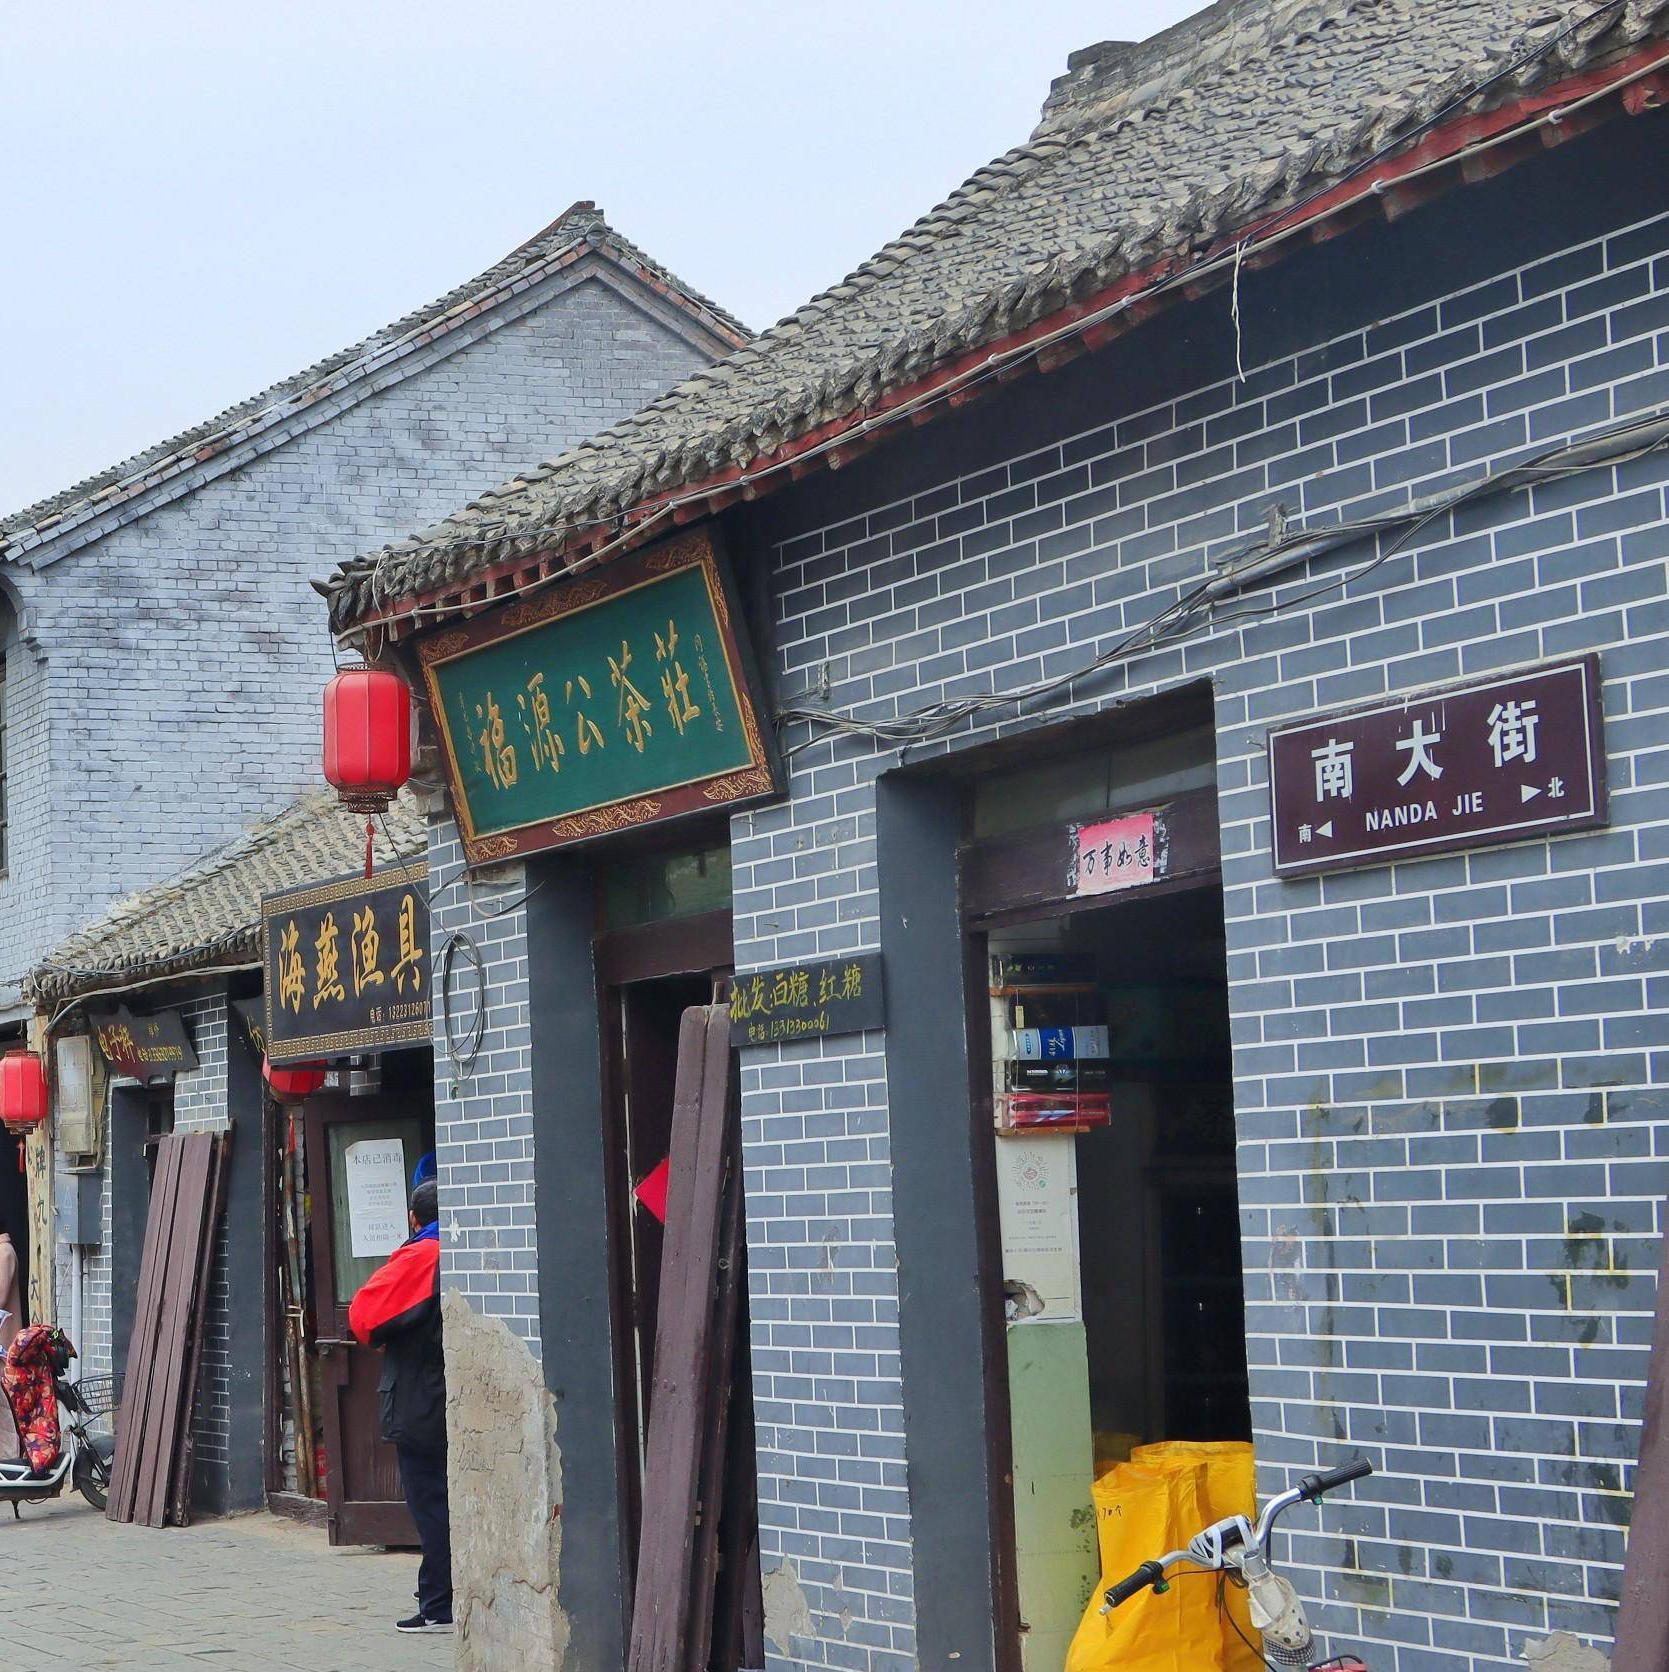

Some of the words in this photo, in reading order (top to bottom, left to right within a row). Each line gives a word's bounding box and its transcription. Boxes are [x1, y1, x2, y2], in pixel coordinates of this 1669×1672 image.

[1311, 699, 1539, 802] 南大街
[1547, 777, 1565, 799] 北
[1366, 801, 1438, 832] NANDA
[1452, 791, 1484, 817] JIE
[1298, 823, 1312, 844] 南
[1083, 834, 1151, 877] 万事如意
[277, 893, 423, 1015] 海燕渔具
